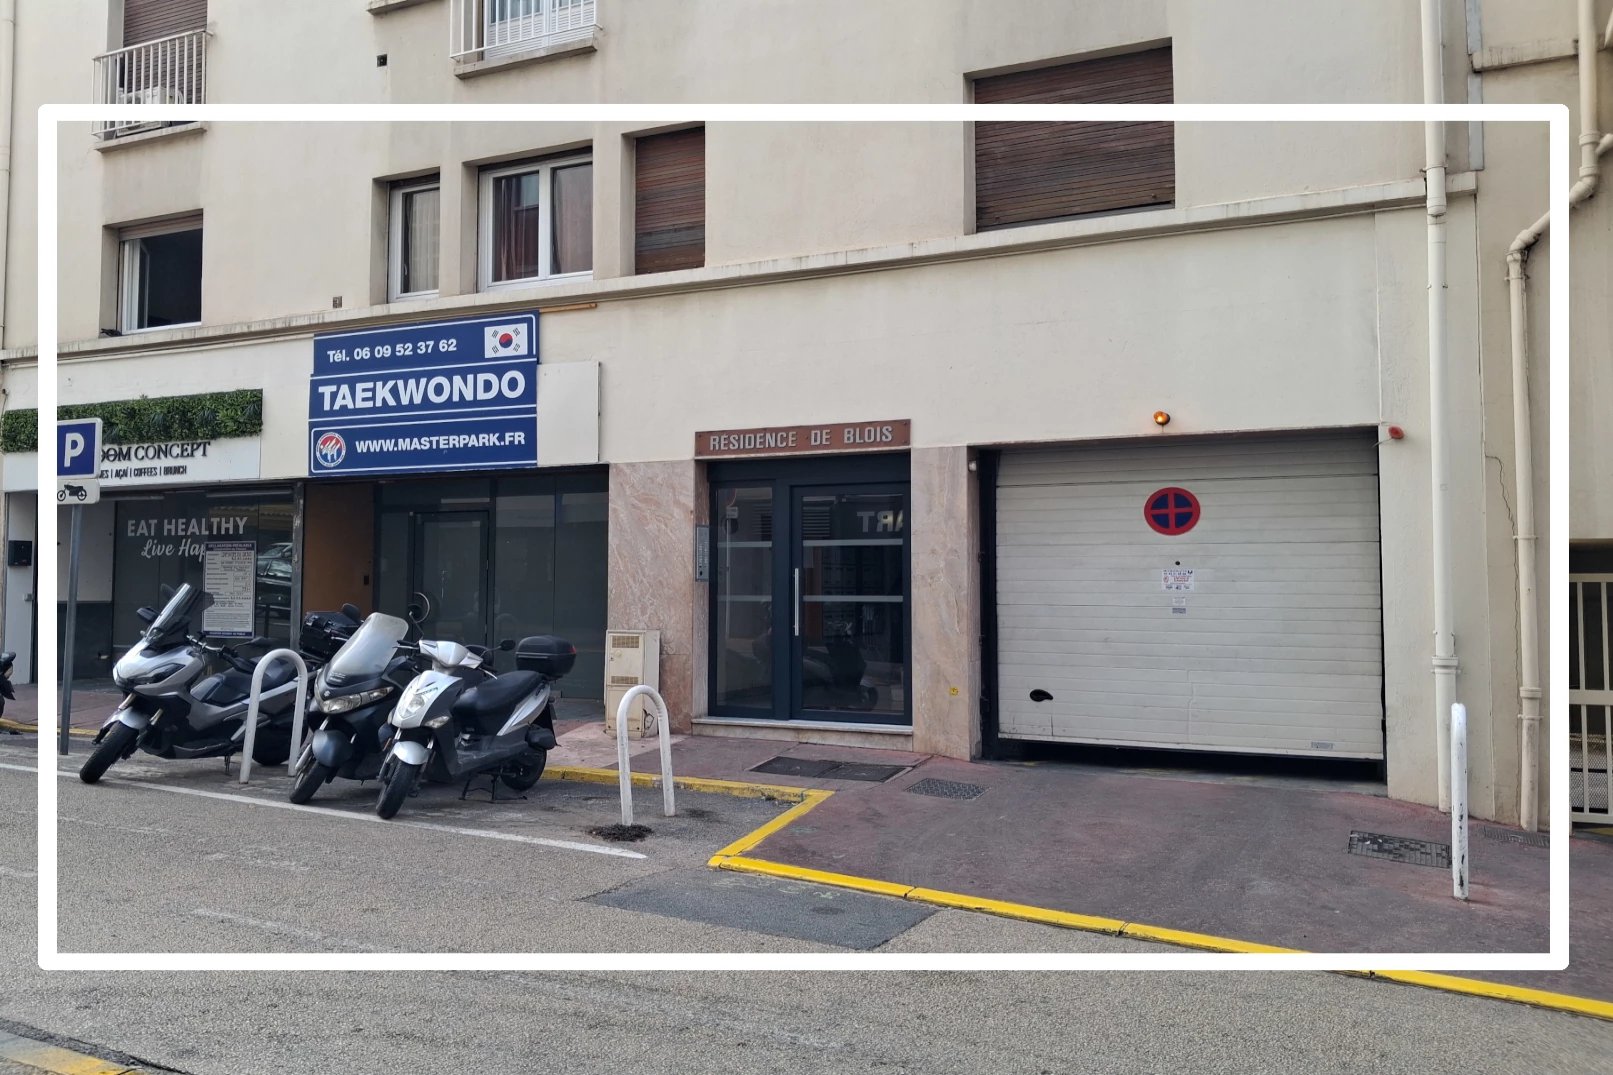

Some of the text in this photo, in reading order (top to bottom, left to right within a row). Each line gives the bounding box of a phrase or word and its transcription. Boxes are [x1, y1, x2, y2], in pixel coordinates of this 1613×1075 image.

[327, 338, 457, 363] Tél. 06 09 52 37 62
[318, 370, 526, 411] TAEKWONDO
[355, 431, 526, 453] WWW.MASTERPARK.FR
[810, 429, 831, 446] DE
[843, 425, 893, 443] BLOIS
[63, 432, 85, 468] P
[134, 441, 211, 461] CONCEPT
[133, 466, 158, 477] COFFEES
[127, 516, 249, 537] EAT HEALTHY
[141, 539, 175, 559] Live
